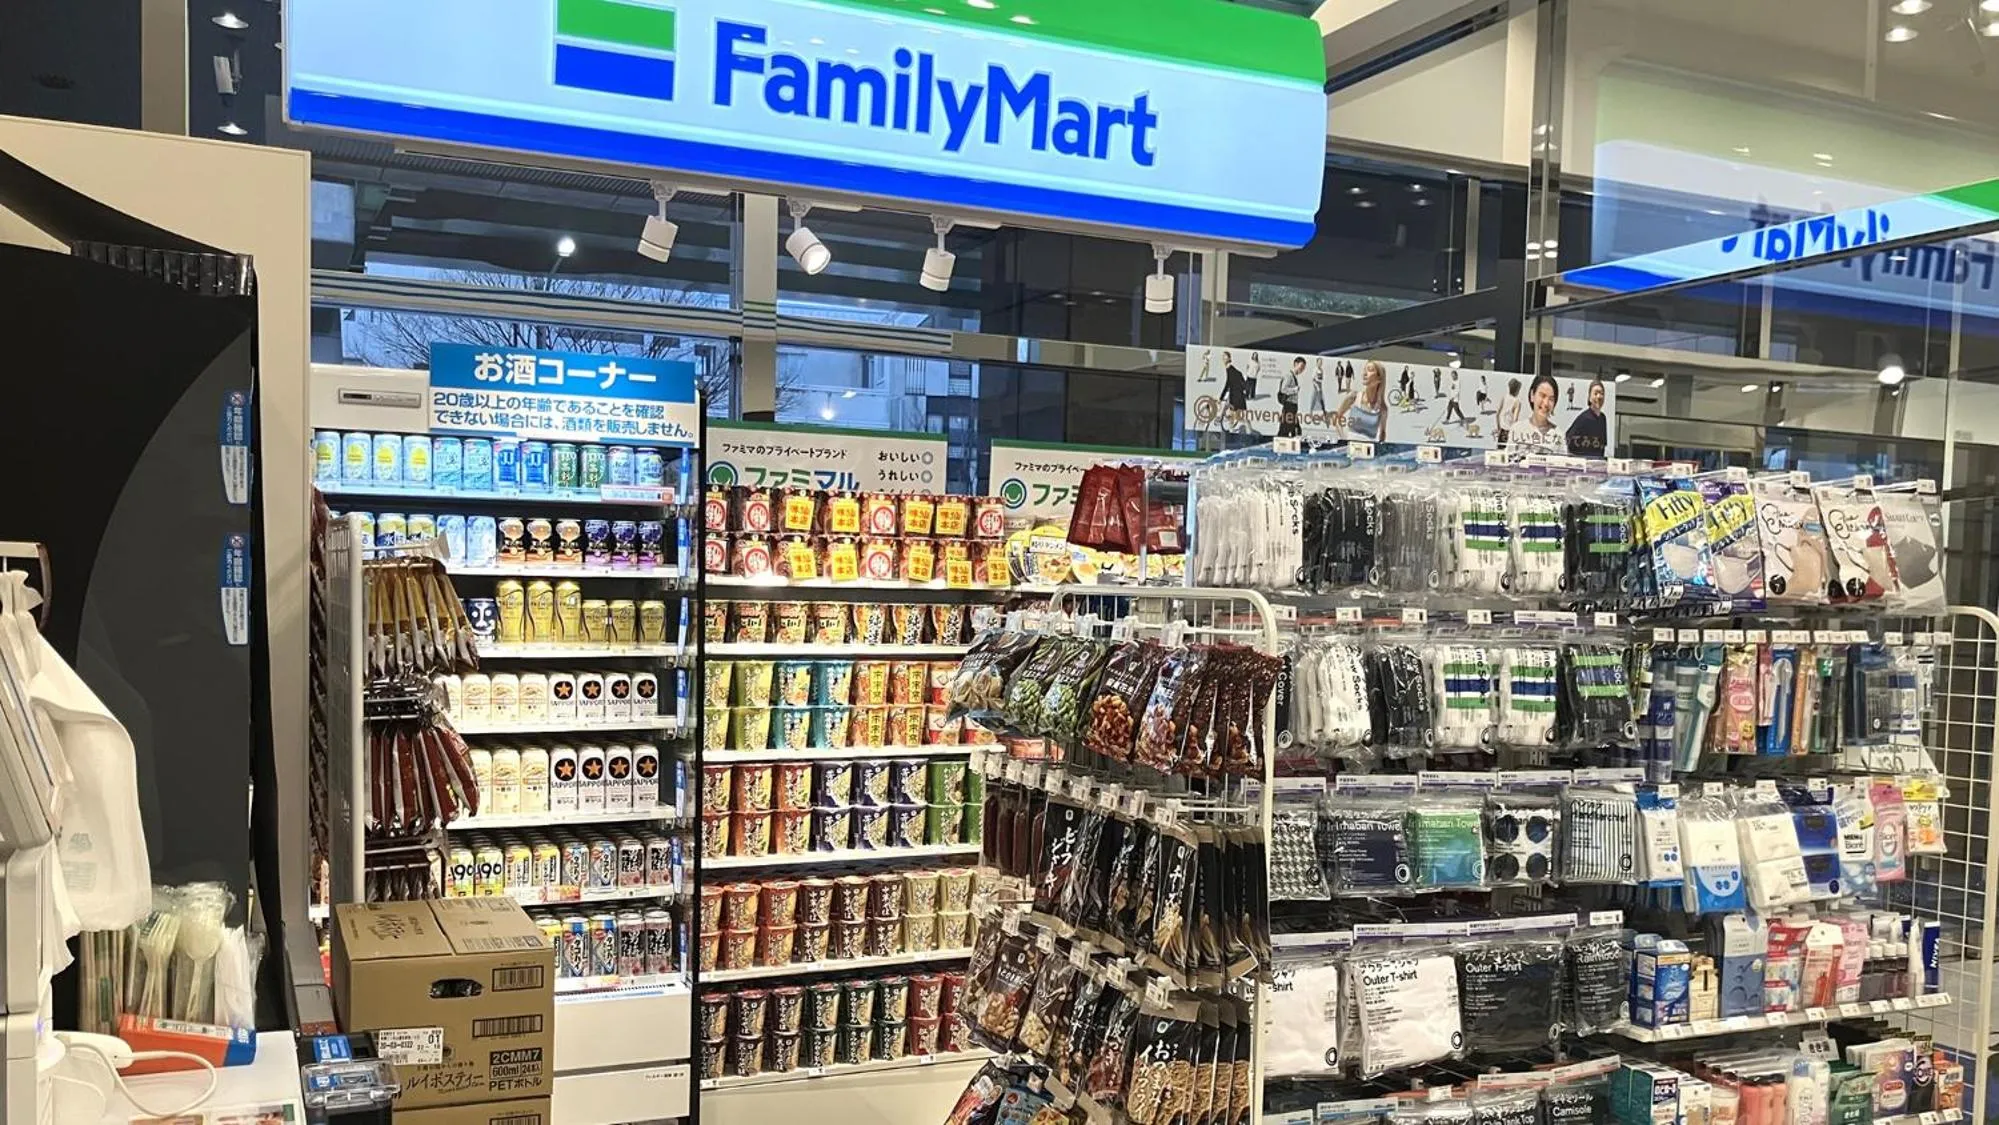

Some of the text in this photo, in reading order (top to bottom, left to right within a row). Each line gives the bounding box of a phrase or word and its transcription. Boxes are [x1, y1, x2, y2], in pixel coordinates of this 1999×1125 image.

[713, 21, 1159, 166] FamilyMart
[474, 353, 657, 389] お酒コーナー
[433, 392, 665, 420] 20歳以上の年齢であることを確認
[434, 409, 694, 438] できない場合には、酒類を販売しません。
[722, 443, 847, 460] ファミマのプライベートブランド
[878, 451, 920, 463] おいしい
[745, 466, 861, 490] ファミマル
[878, 470, 919, 482] うれしい
[1657, 494, 1697, 520] Fitty
[1277, 672, 1288, 707] Cover
[1930, 938, 1941, 969] NIVEA
[1465, 963, 1492, 973] Outer
[1363, 969, 1418, 987] Outer T-shirt
[1267, 982, 1294, 993] -shirt
[428, 1034, 440, 1045] 01
[492, 1051, 540, 1064] 2CMM7
[492, 1066, 519, 1078] 600ml
[406, 1072, 484, 1090] ルイボスティー
[489, 1078, 542, 1092] PETボトル
[1552, 1104, 1593, 1118] Camisole
